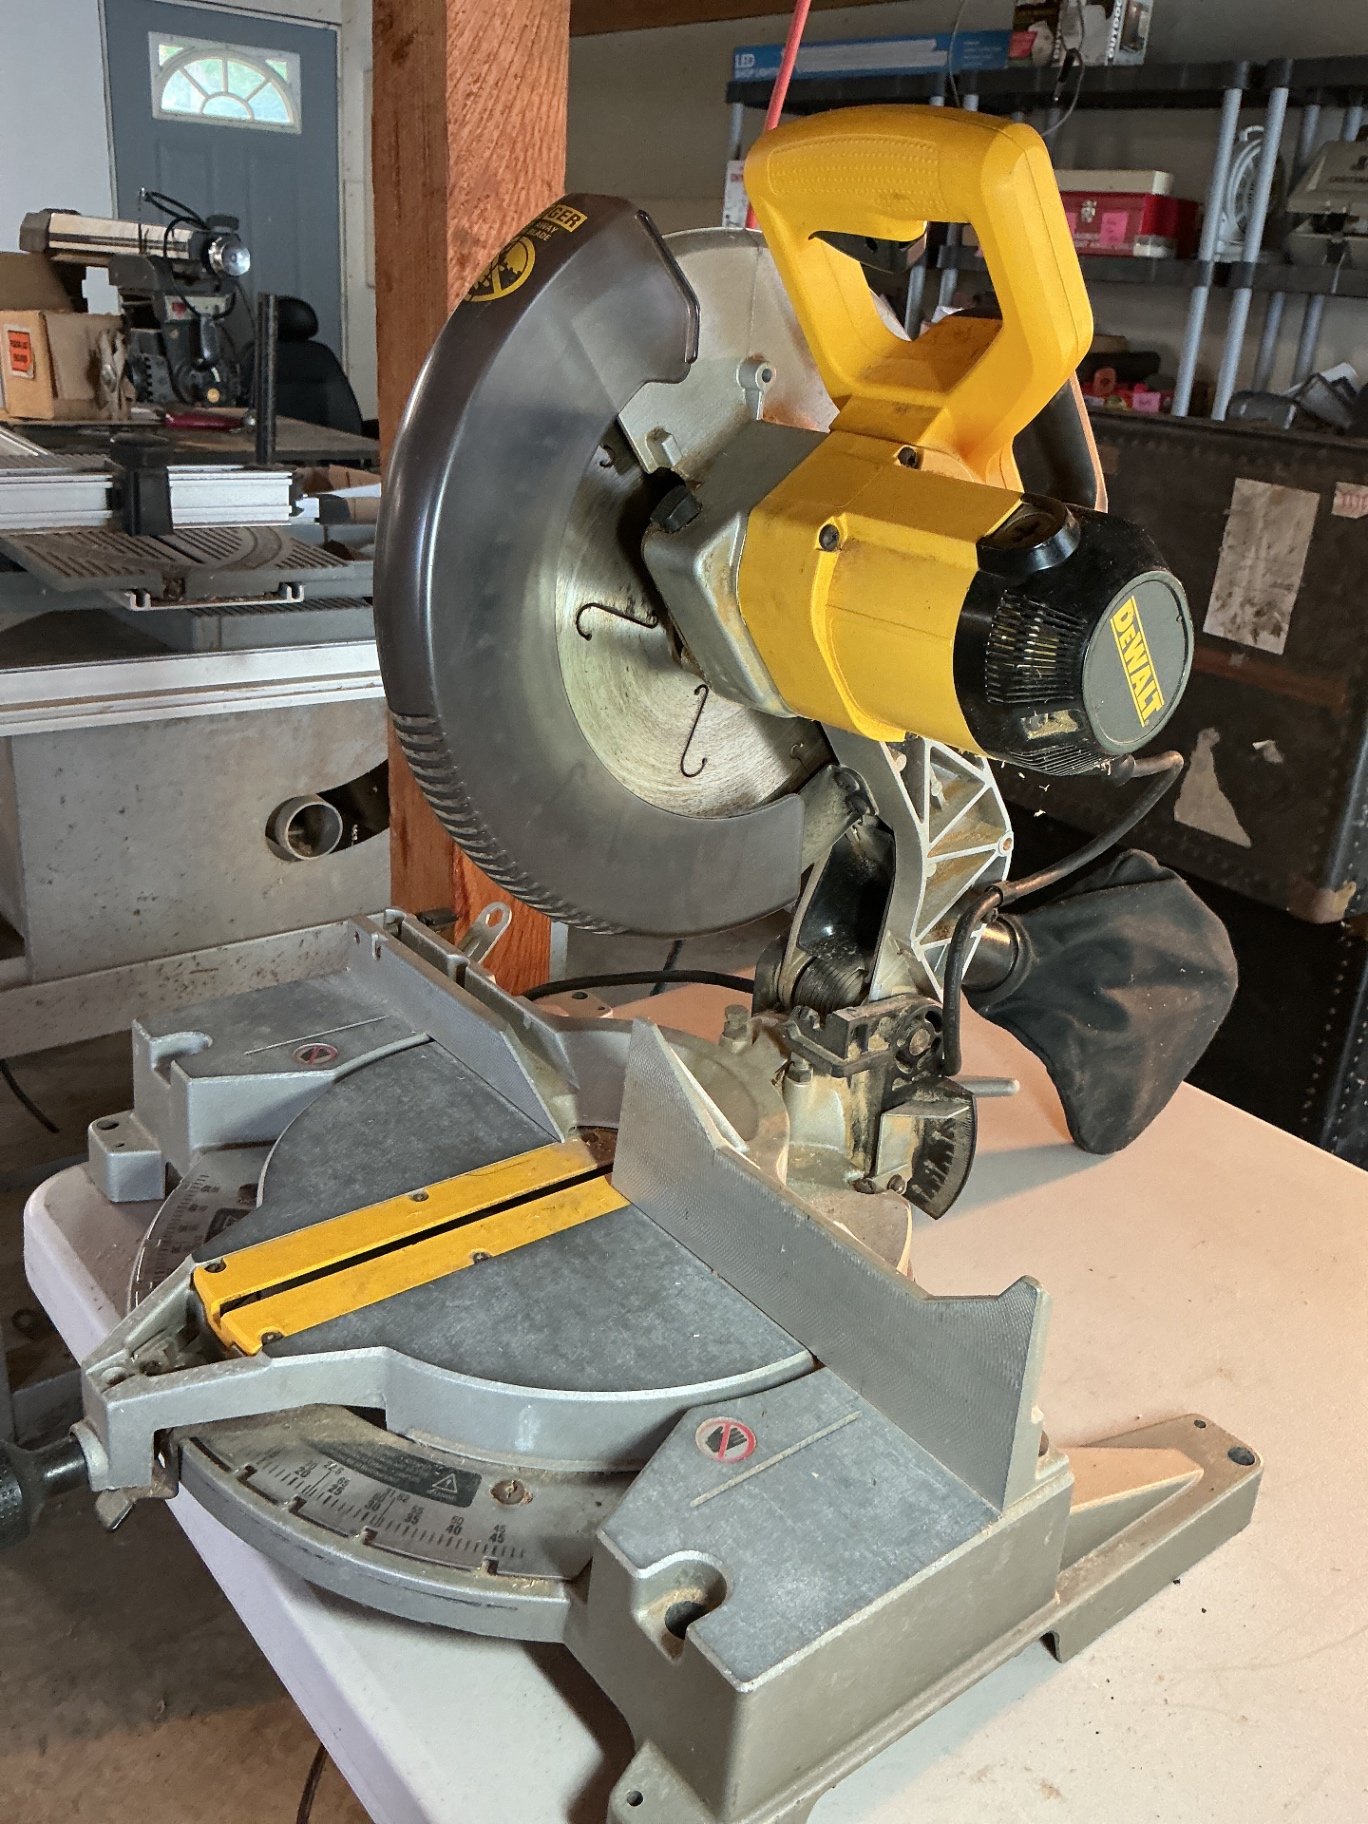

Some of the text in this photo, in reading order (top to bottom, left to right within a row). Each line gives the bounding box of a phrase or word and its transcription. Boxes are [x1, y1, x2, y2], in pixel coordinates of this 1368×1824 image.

[735, 53, 755, 69] LED
[548, 206, 581, 229] GER
[404, 1512, 421, 1525] 35
[446, 1524, 463, 1536] 40
[490, 1532, 507, 1544] 45
